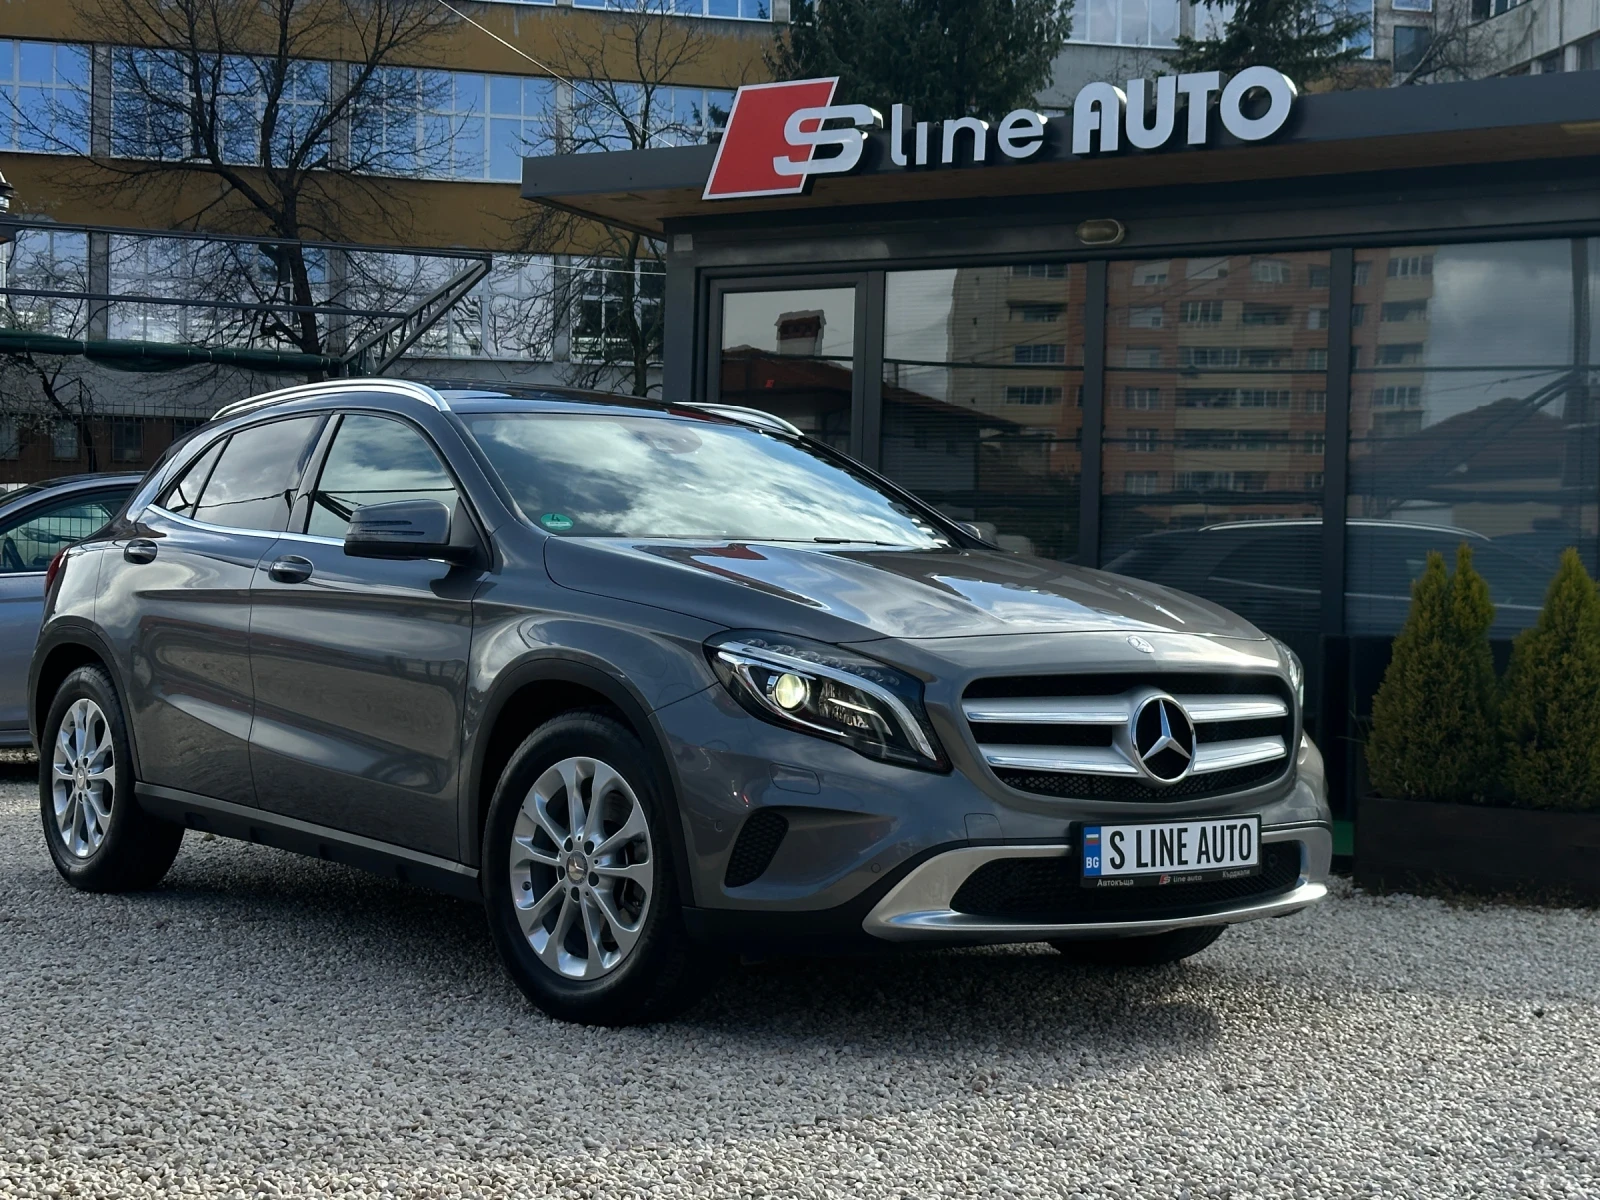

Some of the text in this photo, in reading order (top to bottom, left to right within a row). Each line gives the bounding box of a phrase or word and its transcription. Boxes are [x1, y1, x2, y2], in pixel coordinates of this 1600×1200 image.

[773, 66, 1296, 176] S line AUTO
[1110, 823, 1252, 869] S LINE AUTO
[1086, 857, 1100, 869] BG
[1097, 879, 1134, 887] Автокъща
